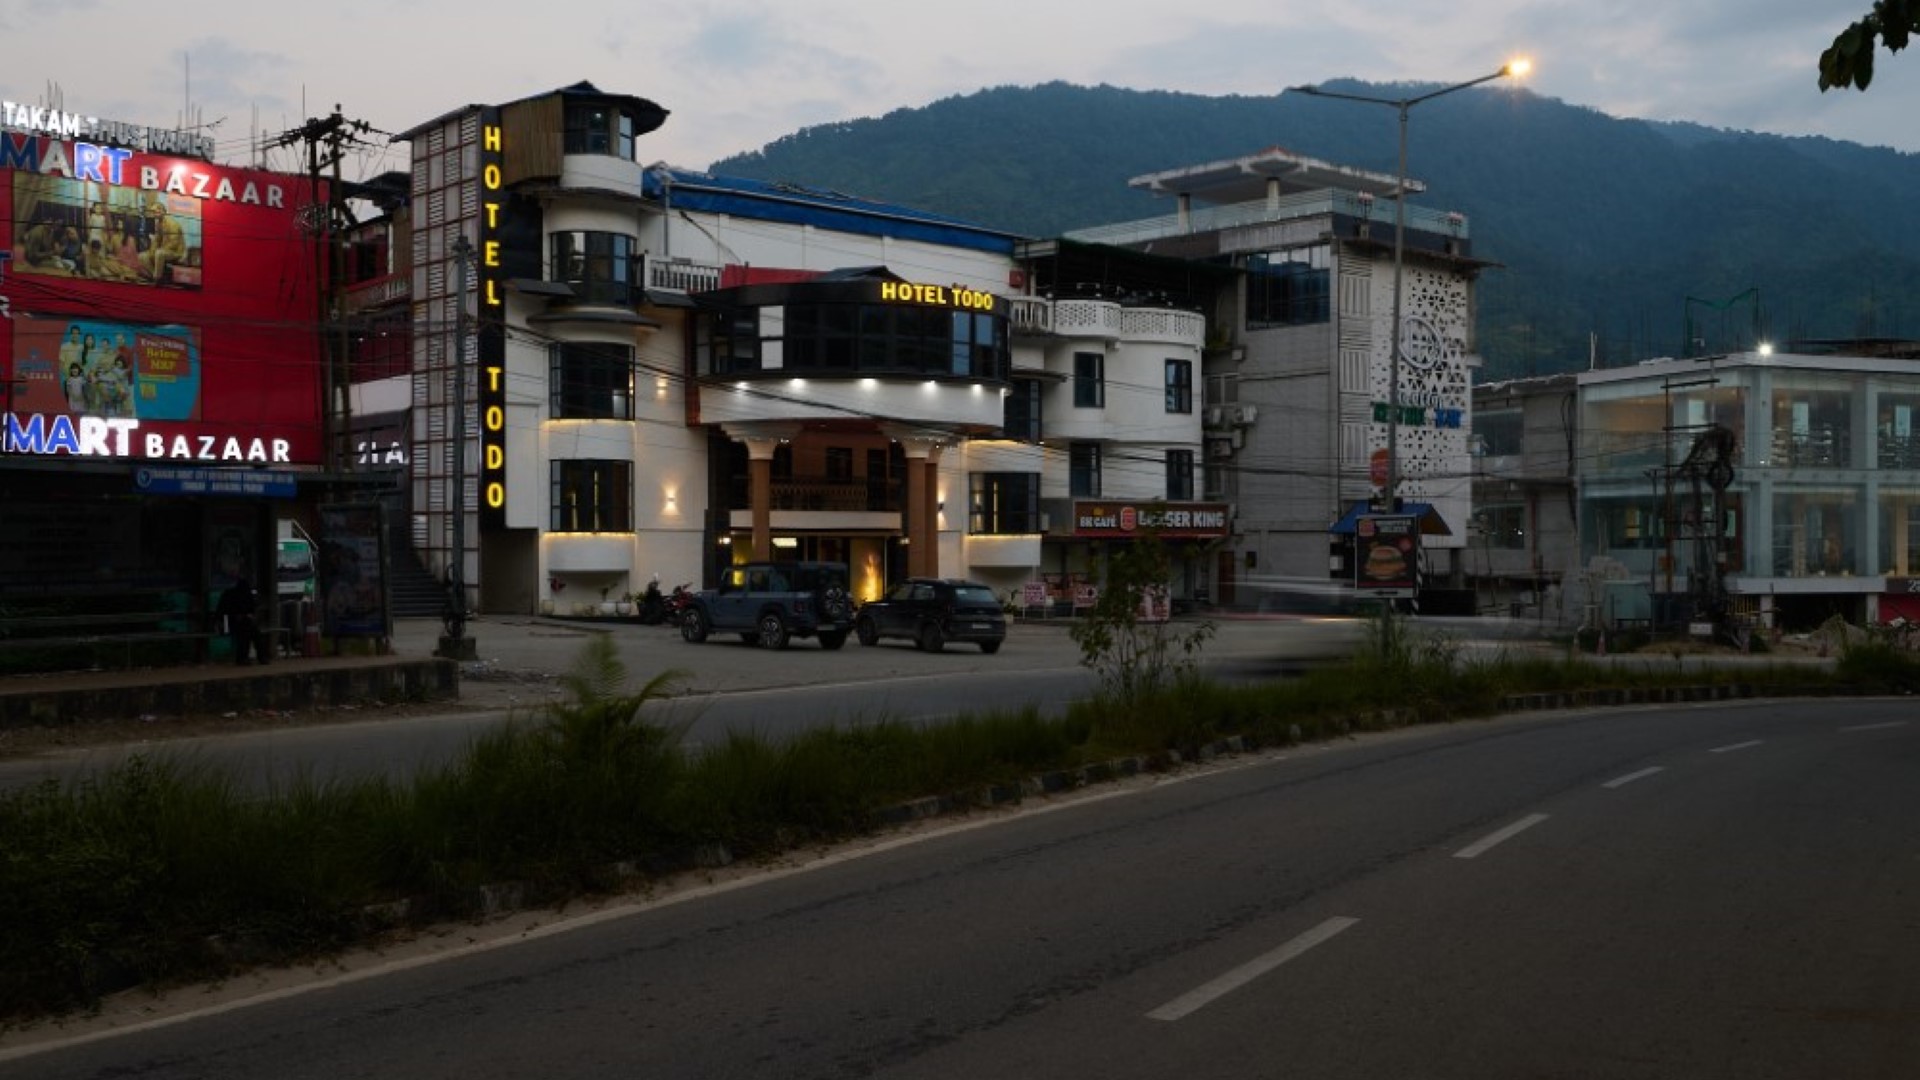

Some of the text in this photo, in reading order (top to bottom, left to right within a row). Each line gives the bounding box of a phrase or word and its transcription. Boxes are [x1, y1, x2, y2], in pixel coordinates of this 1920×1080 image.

[2, 101, 80, 138] TAKAM
[141, 165, 284, 208] BAZAAR
[881, 281, 994, 311] HOTEL TODO
[484, 126, 504, 507] HOTEL TODO
[145, 433, 291, 463] BAZAAR
[1137, 510, 1191, 528] BGER
[1192, 511, 1224, 528] KING
